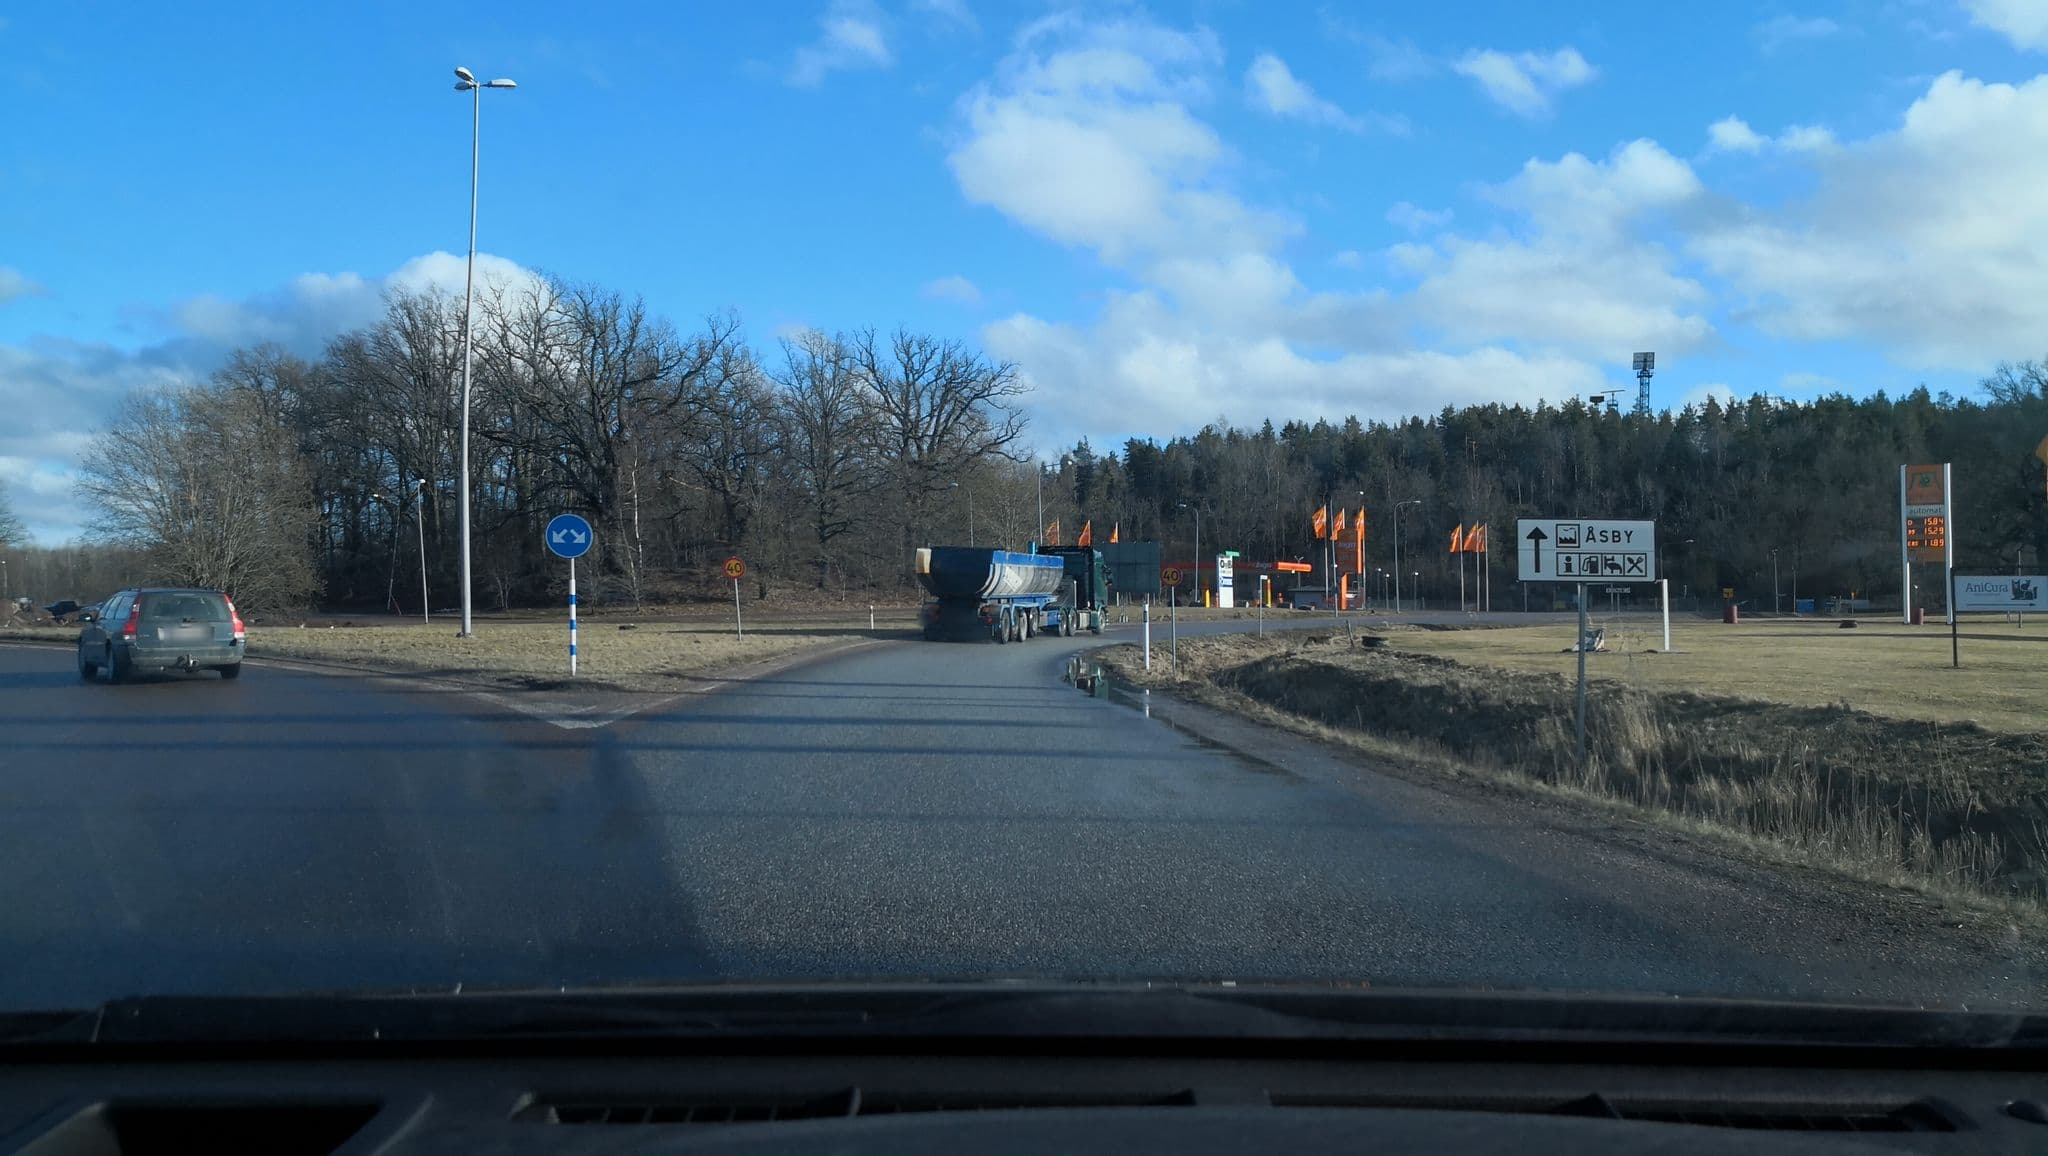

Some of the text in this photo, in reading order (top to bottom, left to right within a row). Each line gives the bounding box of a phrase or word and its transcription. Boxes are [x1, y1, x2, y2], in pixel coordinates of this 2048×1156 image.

[1585, 526, 1633, 543] ÅSBY
[727, 562, 742, 574] 40
[1163, 570, 1179, 581] 40
[1965, 582, 2009, 593] AniCura
